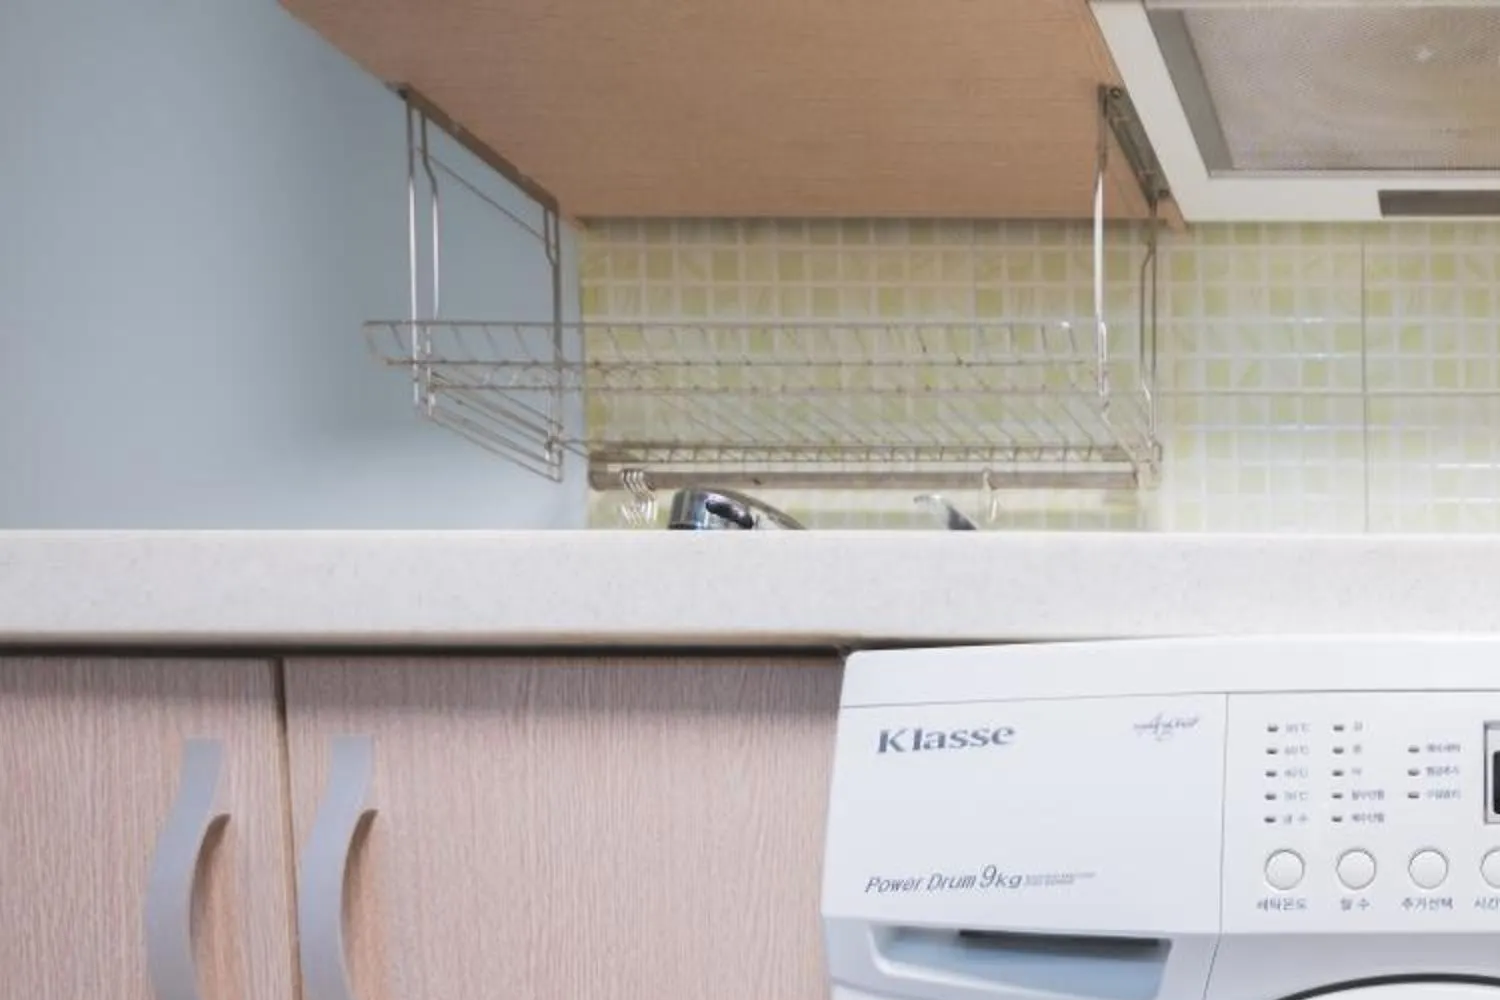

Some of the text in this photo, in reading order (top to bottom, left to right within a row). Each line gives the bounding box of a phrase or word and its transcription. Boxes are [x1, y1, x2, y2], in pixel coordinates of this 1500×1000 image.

[877, 724, 1016, 754] Klasse
[865, 876, 923, 893] Power
[926, 872, 977, 891] Drum
[979, 864, 1022, 890] 9kg
